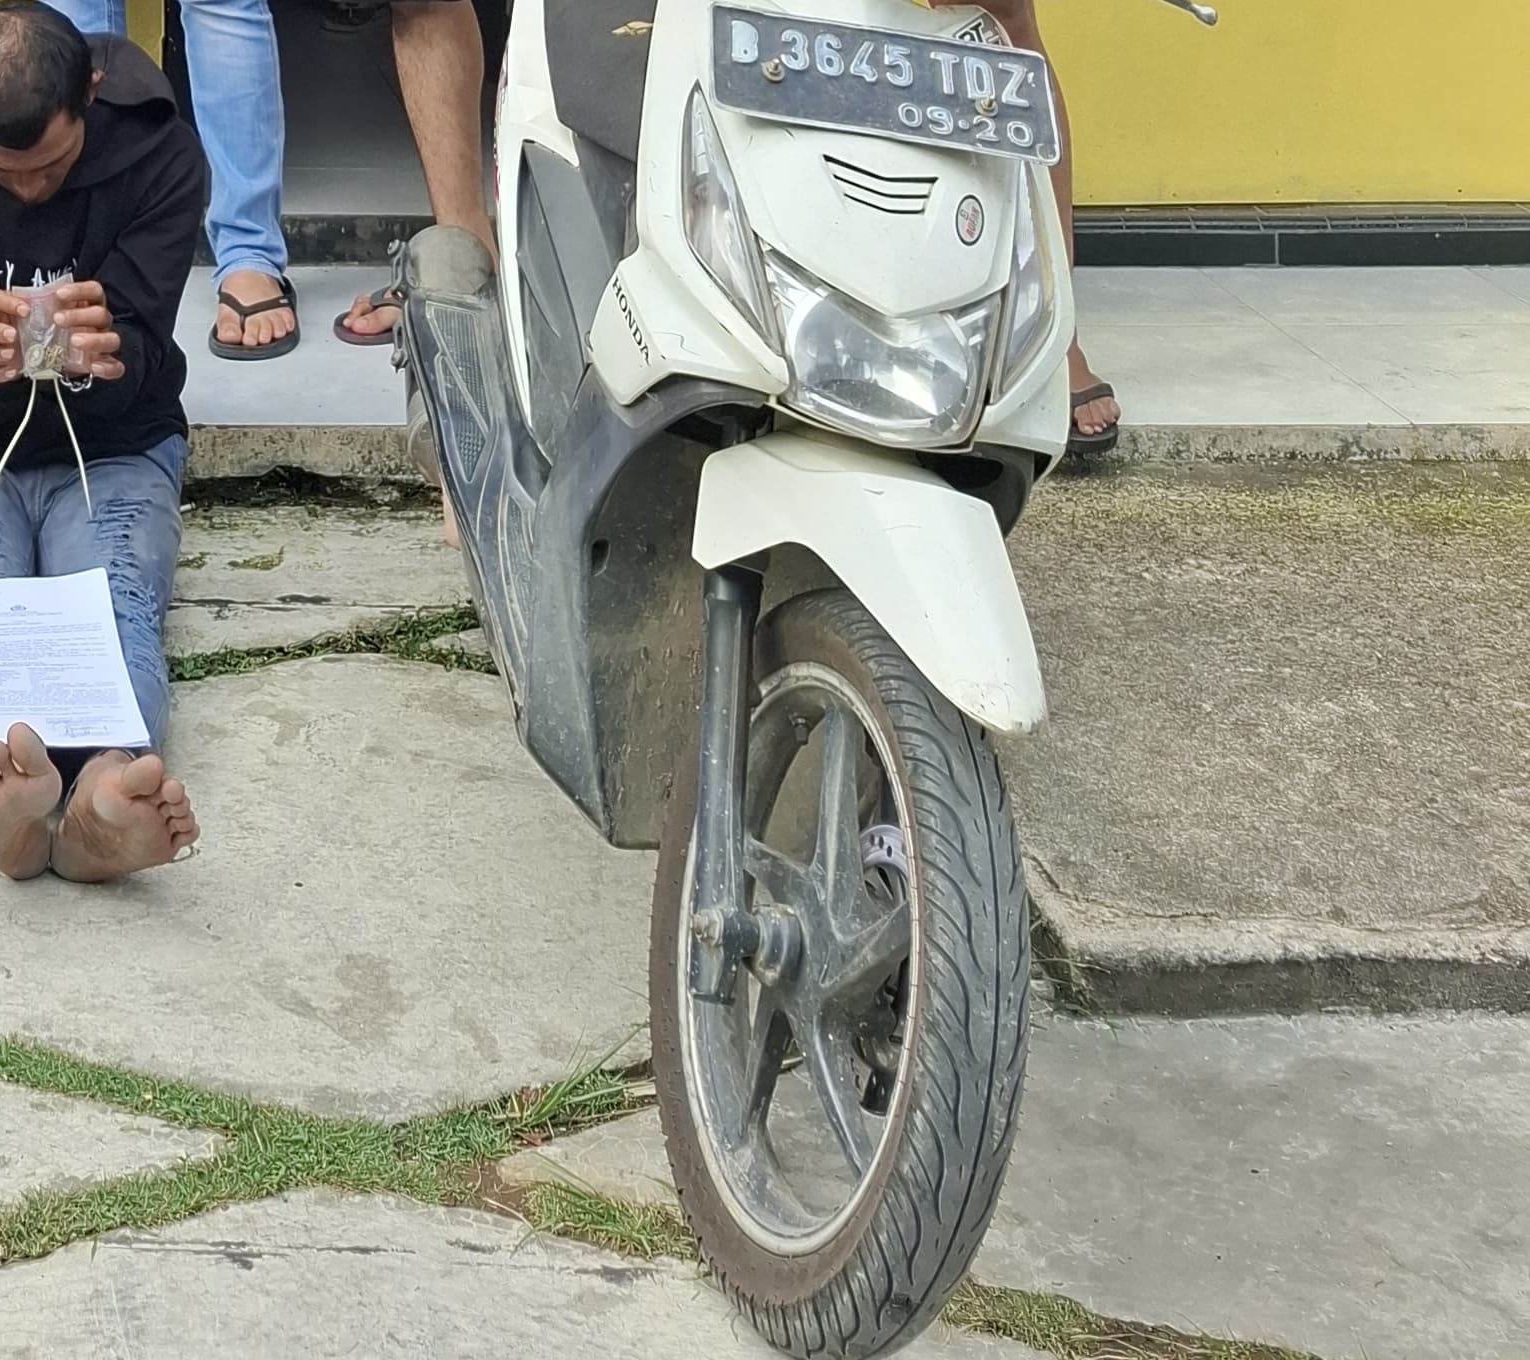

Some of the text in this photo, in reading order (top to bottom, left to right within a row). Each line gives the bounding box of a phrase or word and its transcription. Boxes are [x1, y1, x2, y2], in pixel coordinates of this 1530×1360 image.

[730, 19, 759, 64] B
[780, 28, 915, 88] 3645
[930, 51, 1030, 108] TDZ
[611, 275, 651, 367] HONDA
